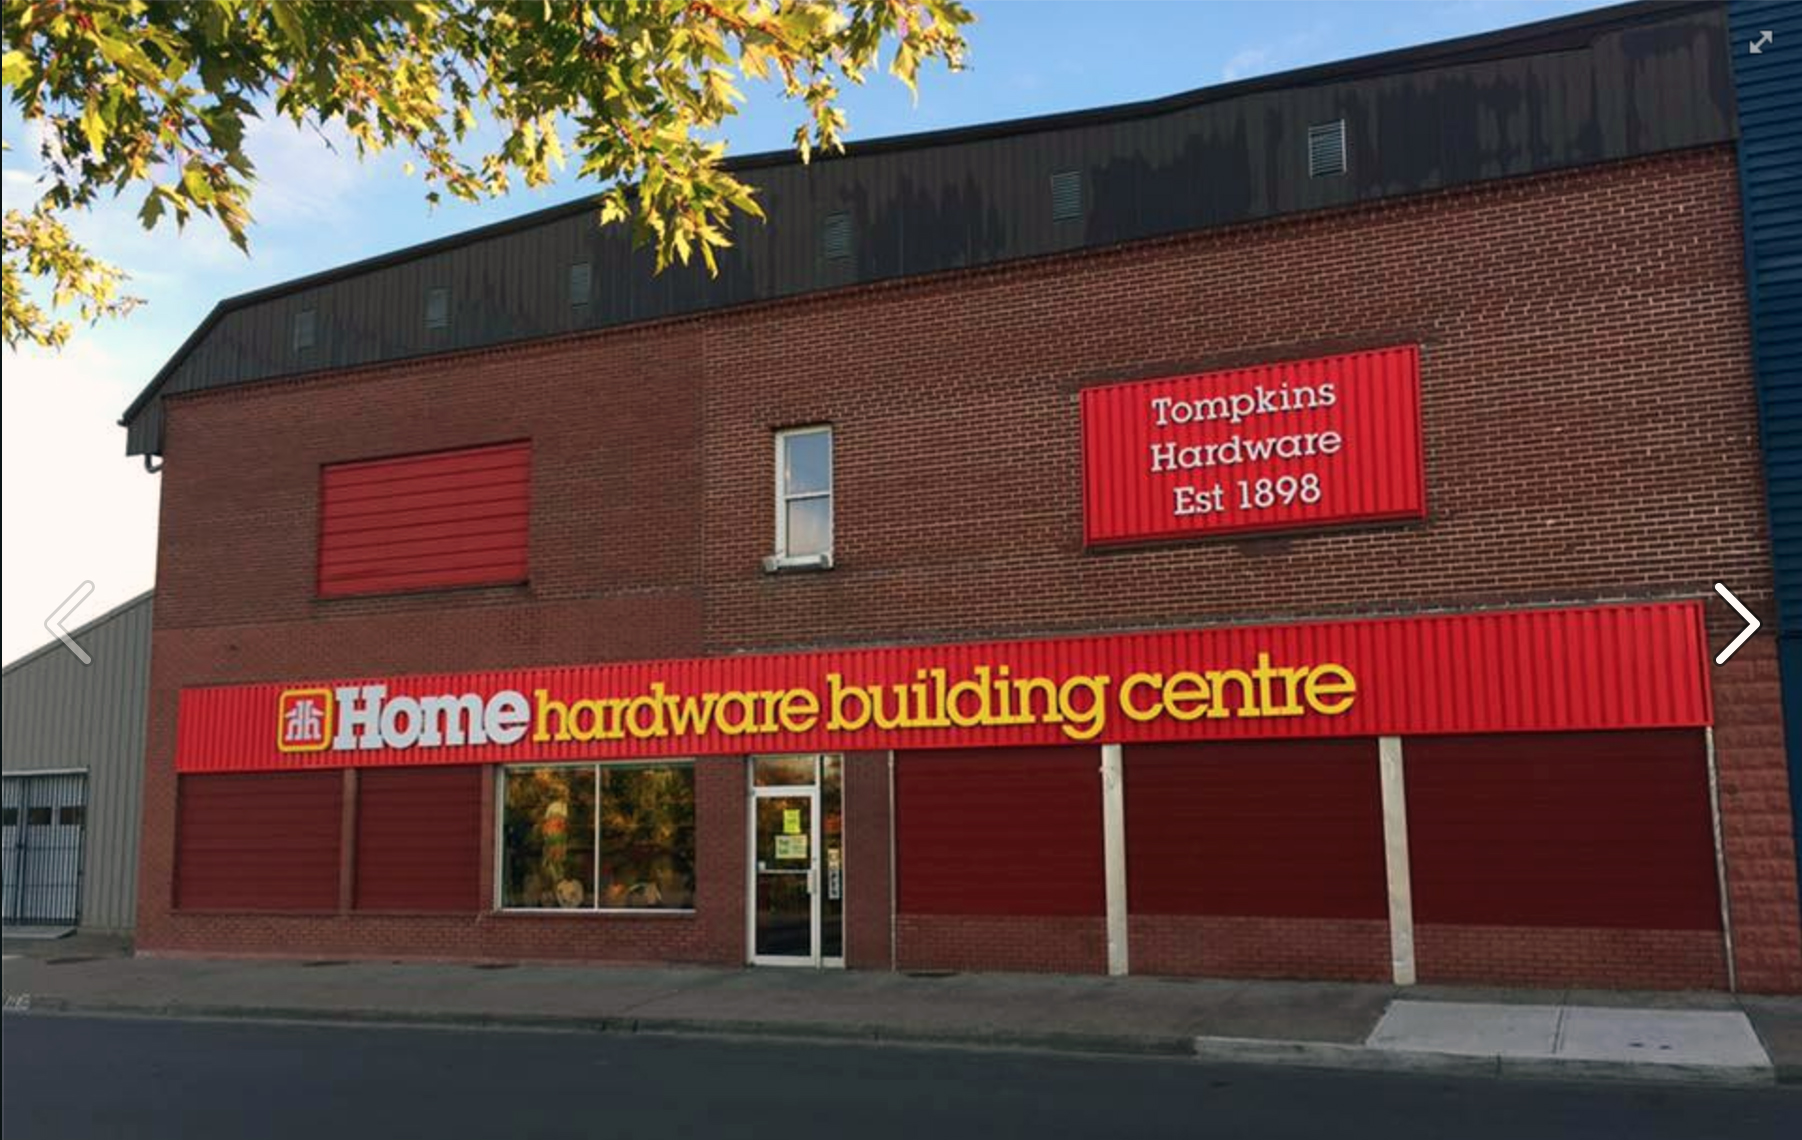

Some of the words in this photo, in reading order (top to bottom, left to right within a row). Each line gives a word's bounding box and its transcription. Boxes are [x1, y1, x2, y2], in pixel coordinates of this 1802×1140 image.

[1152, 383, 1336, 425] Tompkins
[1151, 430, 1341, 472] Hardware
[1174, 484, 1224, 515] Est
[1238, 473, 1321, 509] 1898
[333, 685, 531, 750] Home
[532, 683, 818, 742] hardware
[827, 666, 1109, 739] building
[1120, 653, 1356, 721] centre
